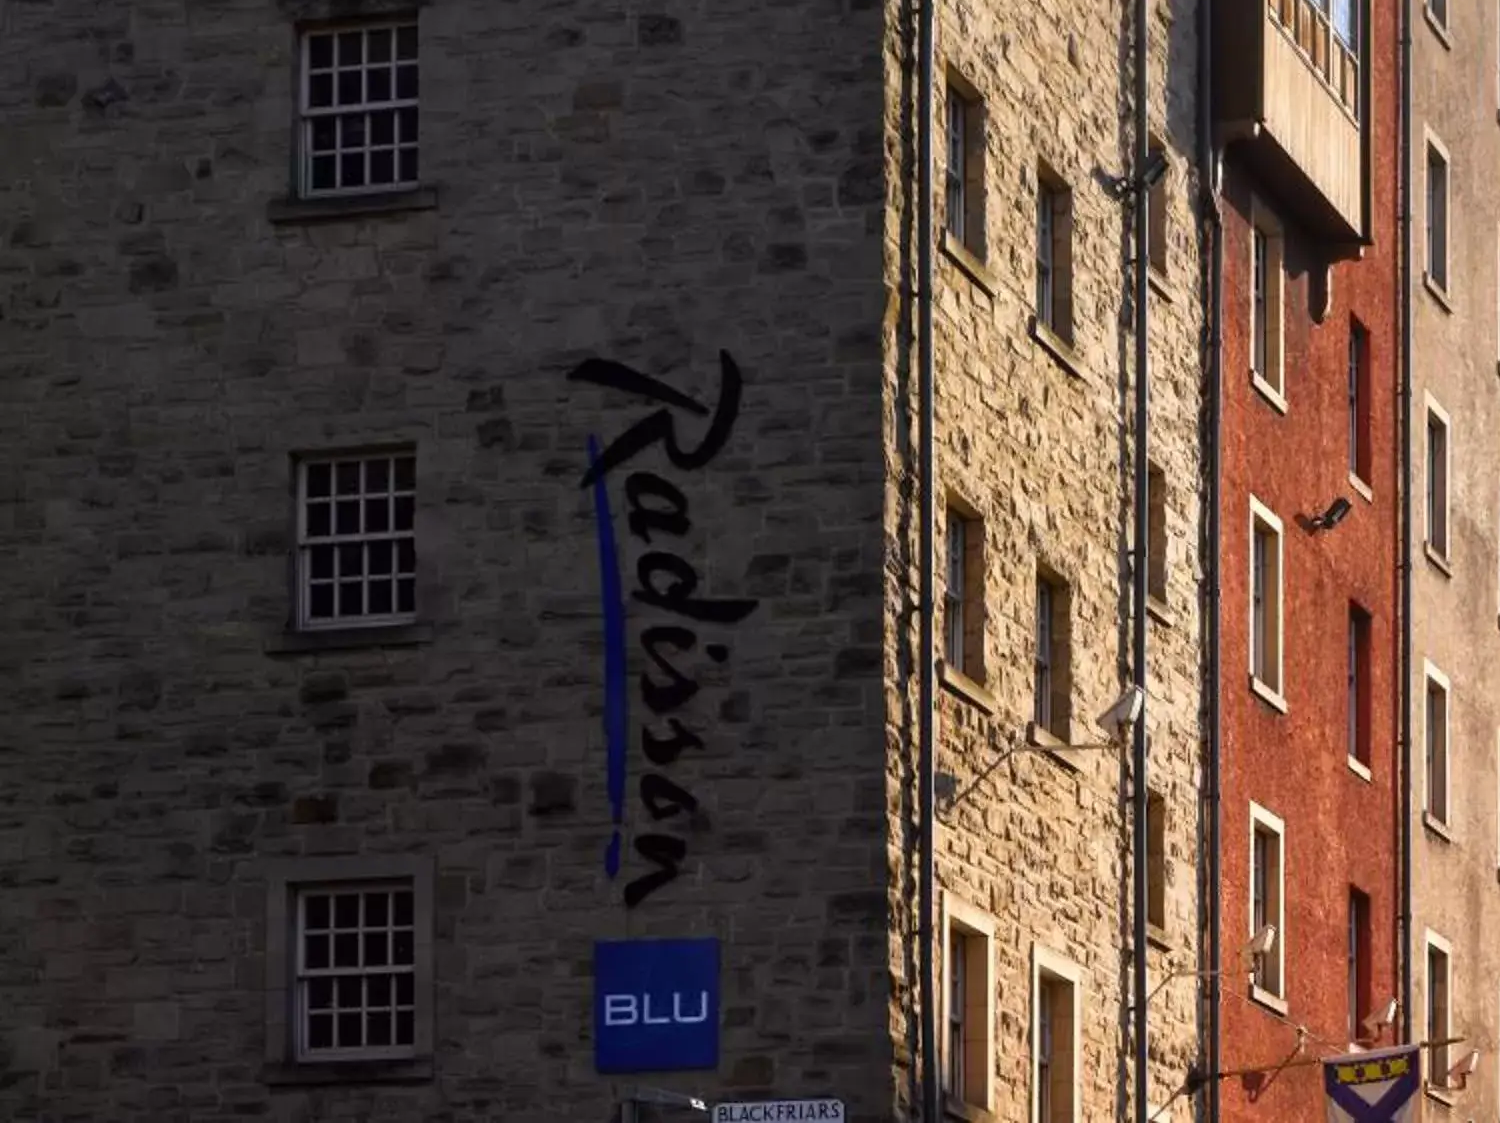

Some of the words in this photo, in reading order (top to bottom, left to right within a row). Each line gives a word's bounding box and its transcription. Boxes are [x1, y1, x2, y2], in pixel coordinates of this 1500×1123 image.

[567, 349, 759, 907] Radisson
[604, 990, 708, 1026] BLU
[717, 1102, 841, 1122] BLACKFRIARS
